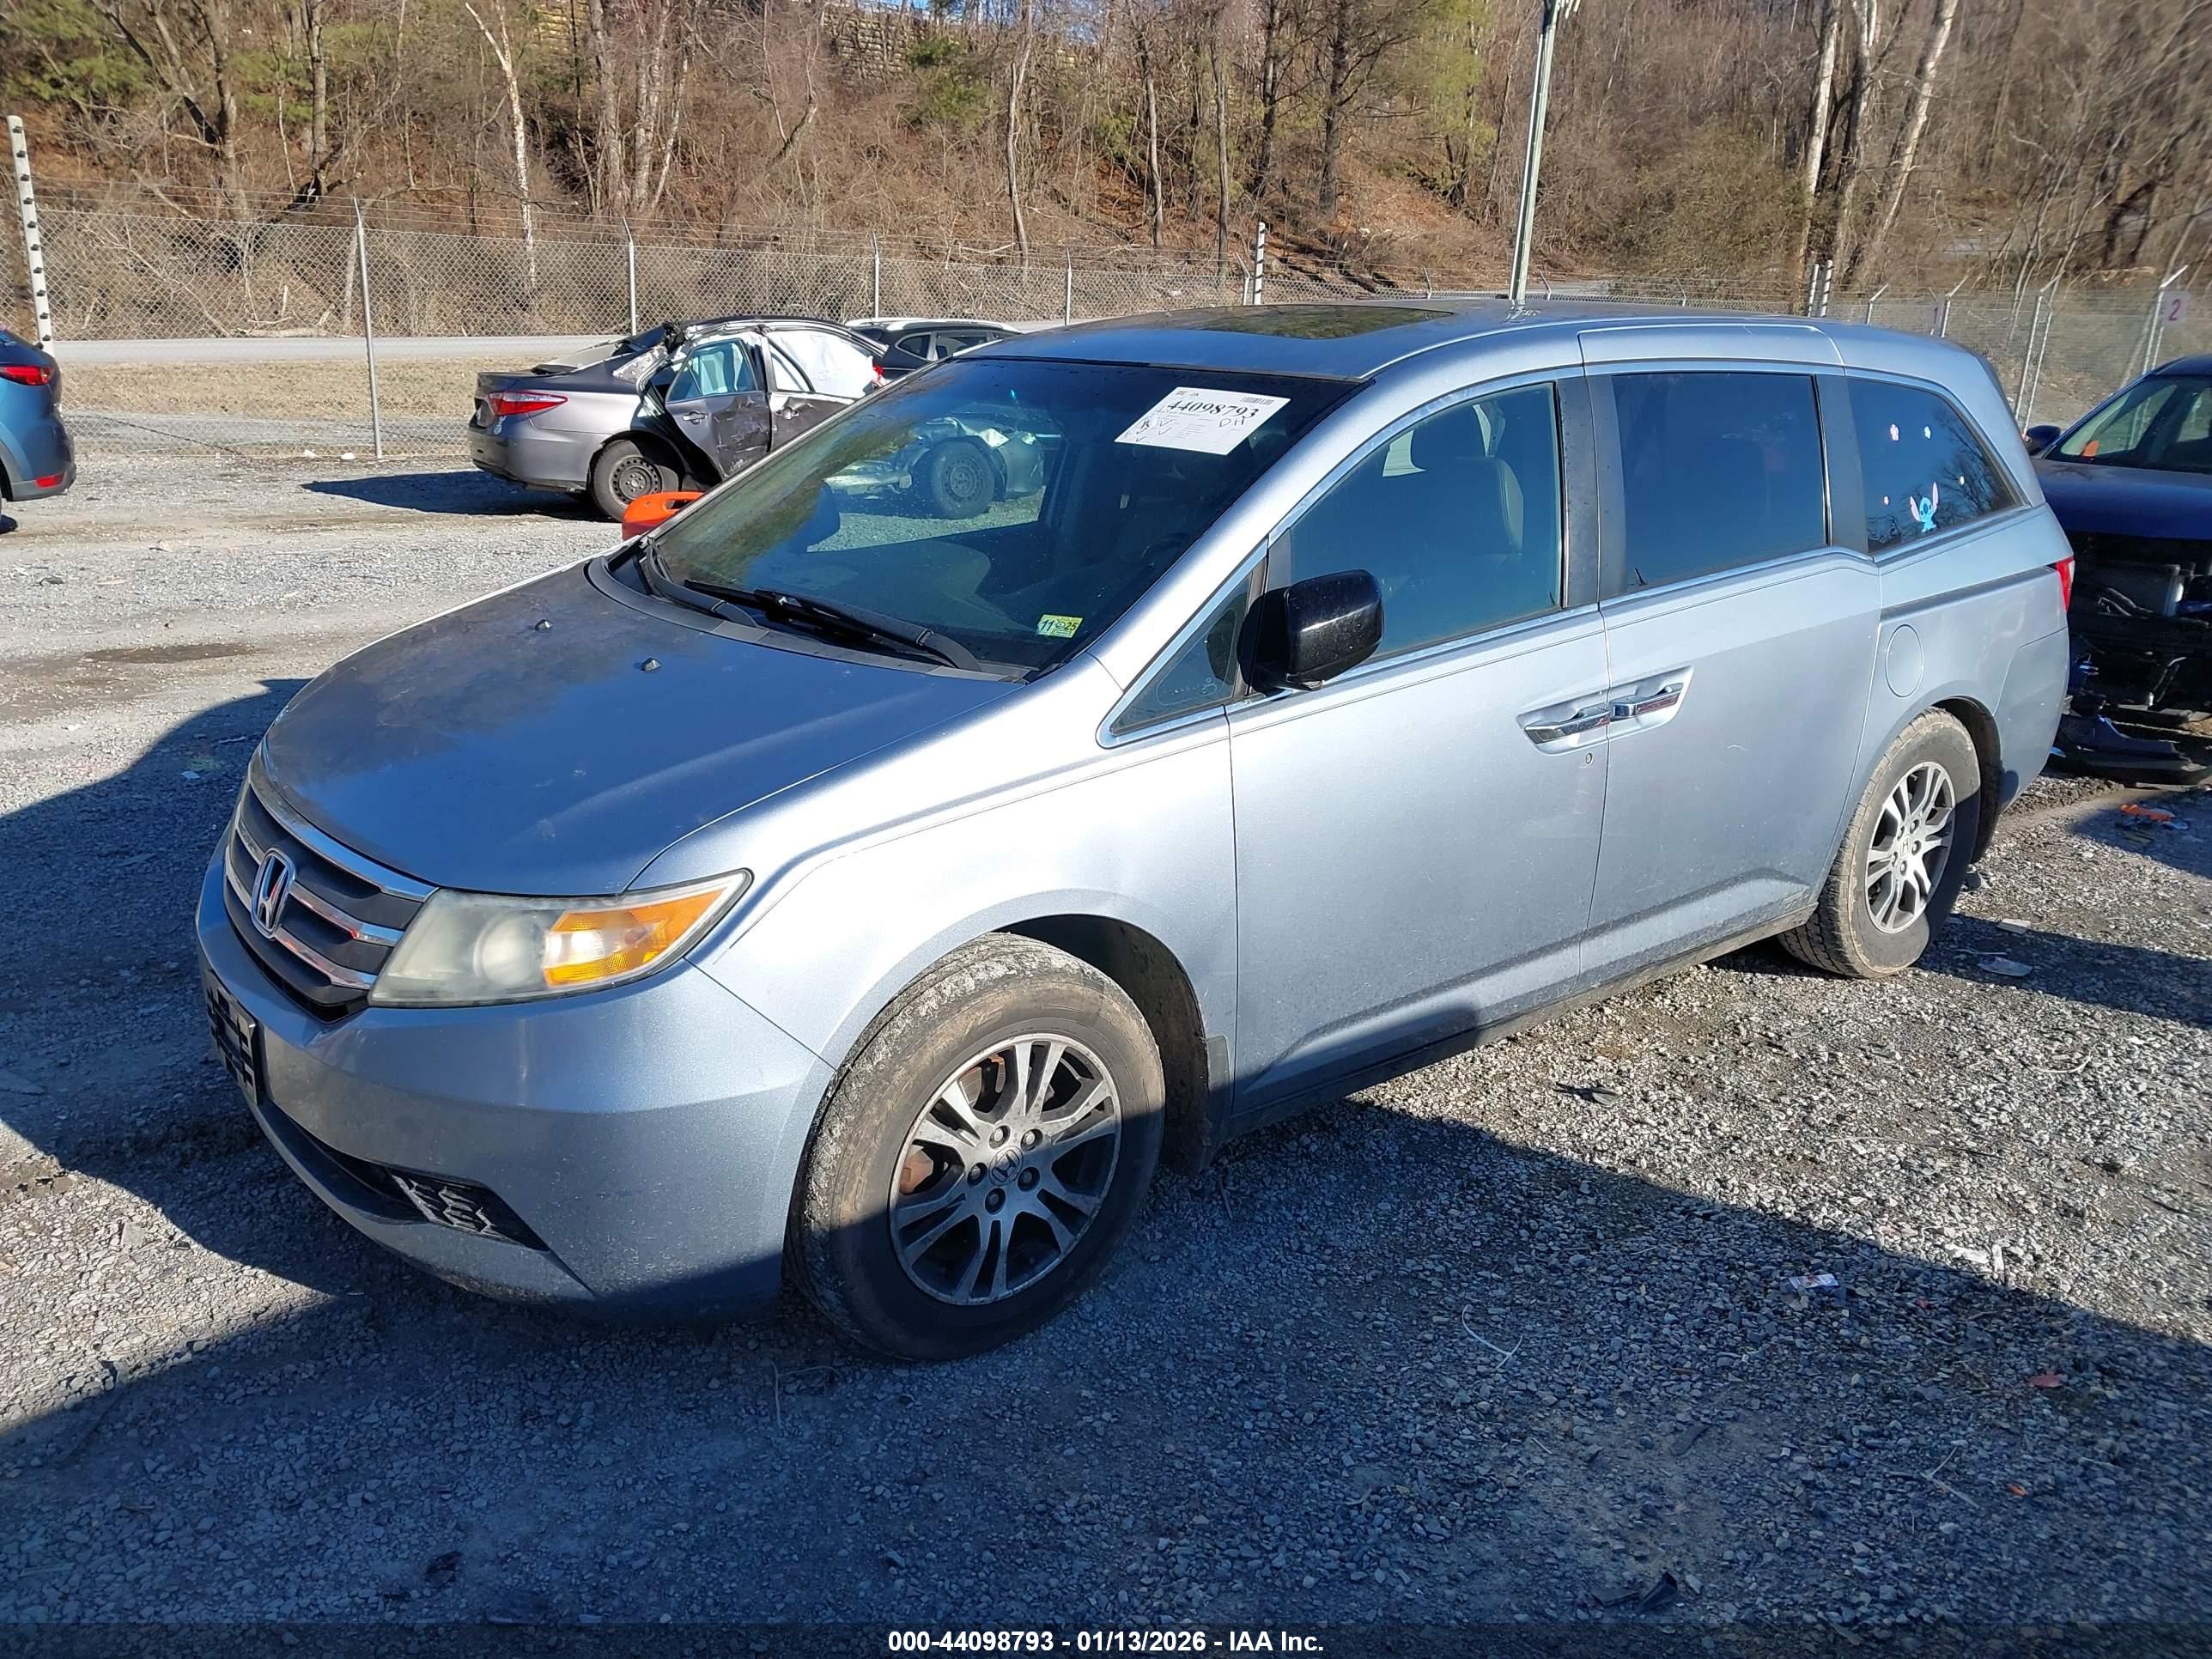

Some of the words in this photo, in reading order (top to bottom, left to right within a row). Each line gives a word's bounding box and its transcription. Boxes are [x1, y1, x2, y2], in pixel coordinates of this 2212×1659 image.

[2169, 298, 2181, 321] 2
[1167, 400, 1260, 419] 44098793
[1040, 619, 1055, 632] 11
[1063, 622, 1079, 631] 25
